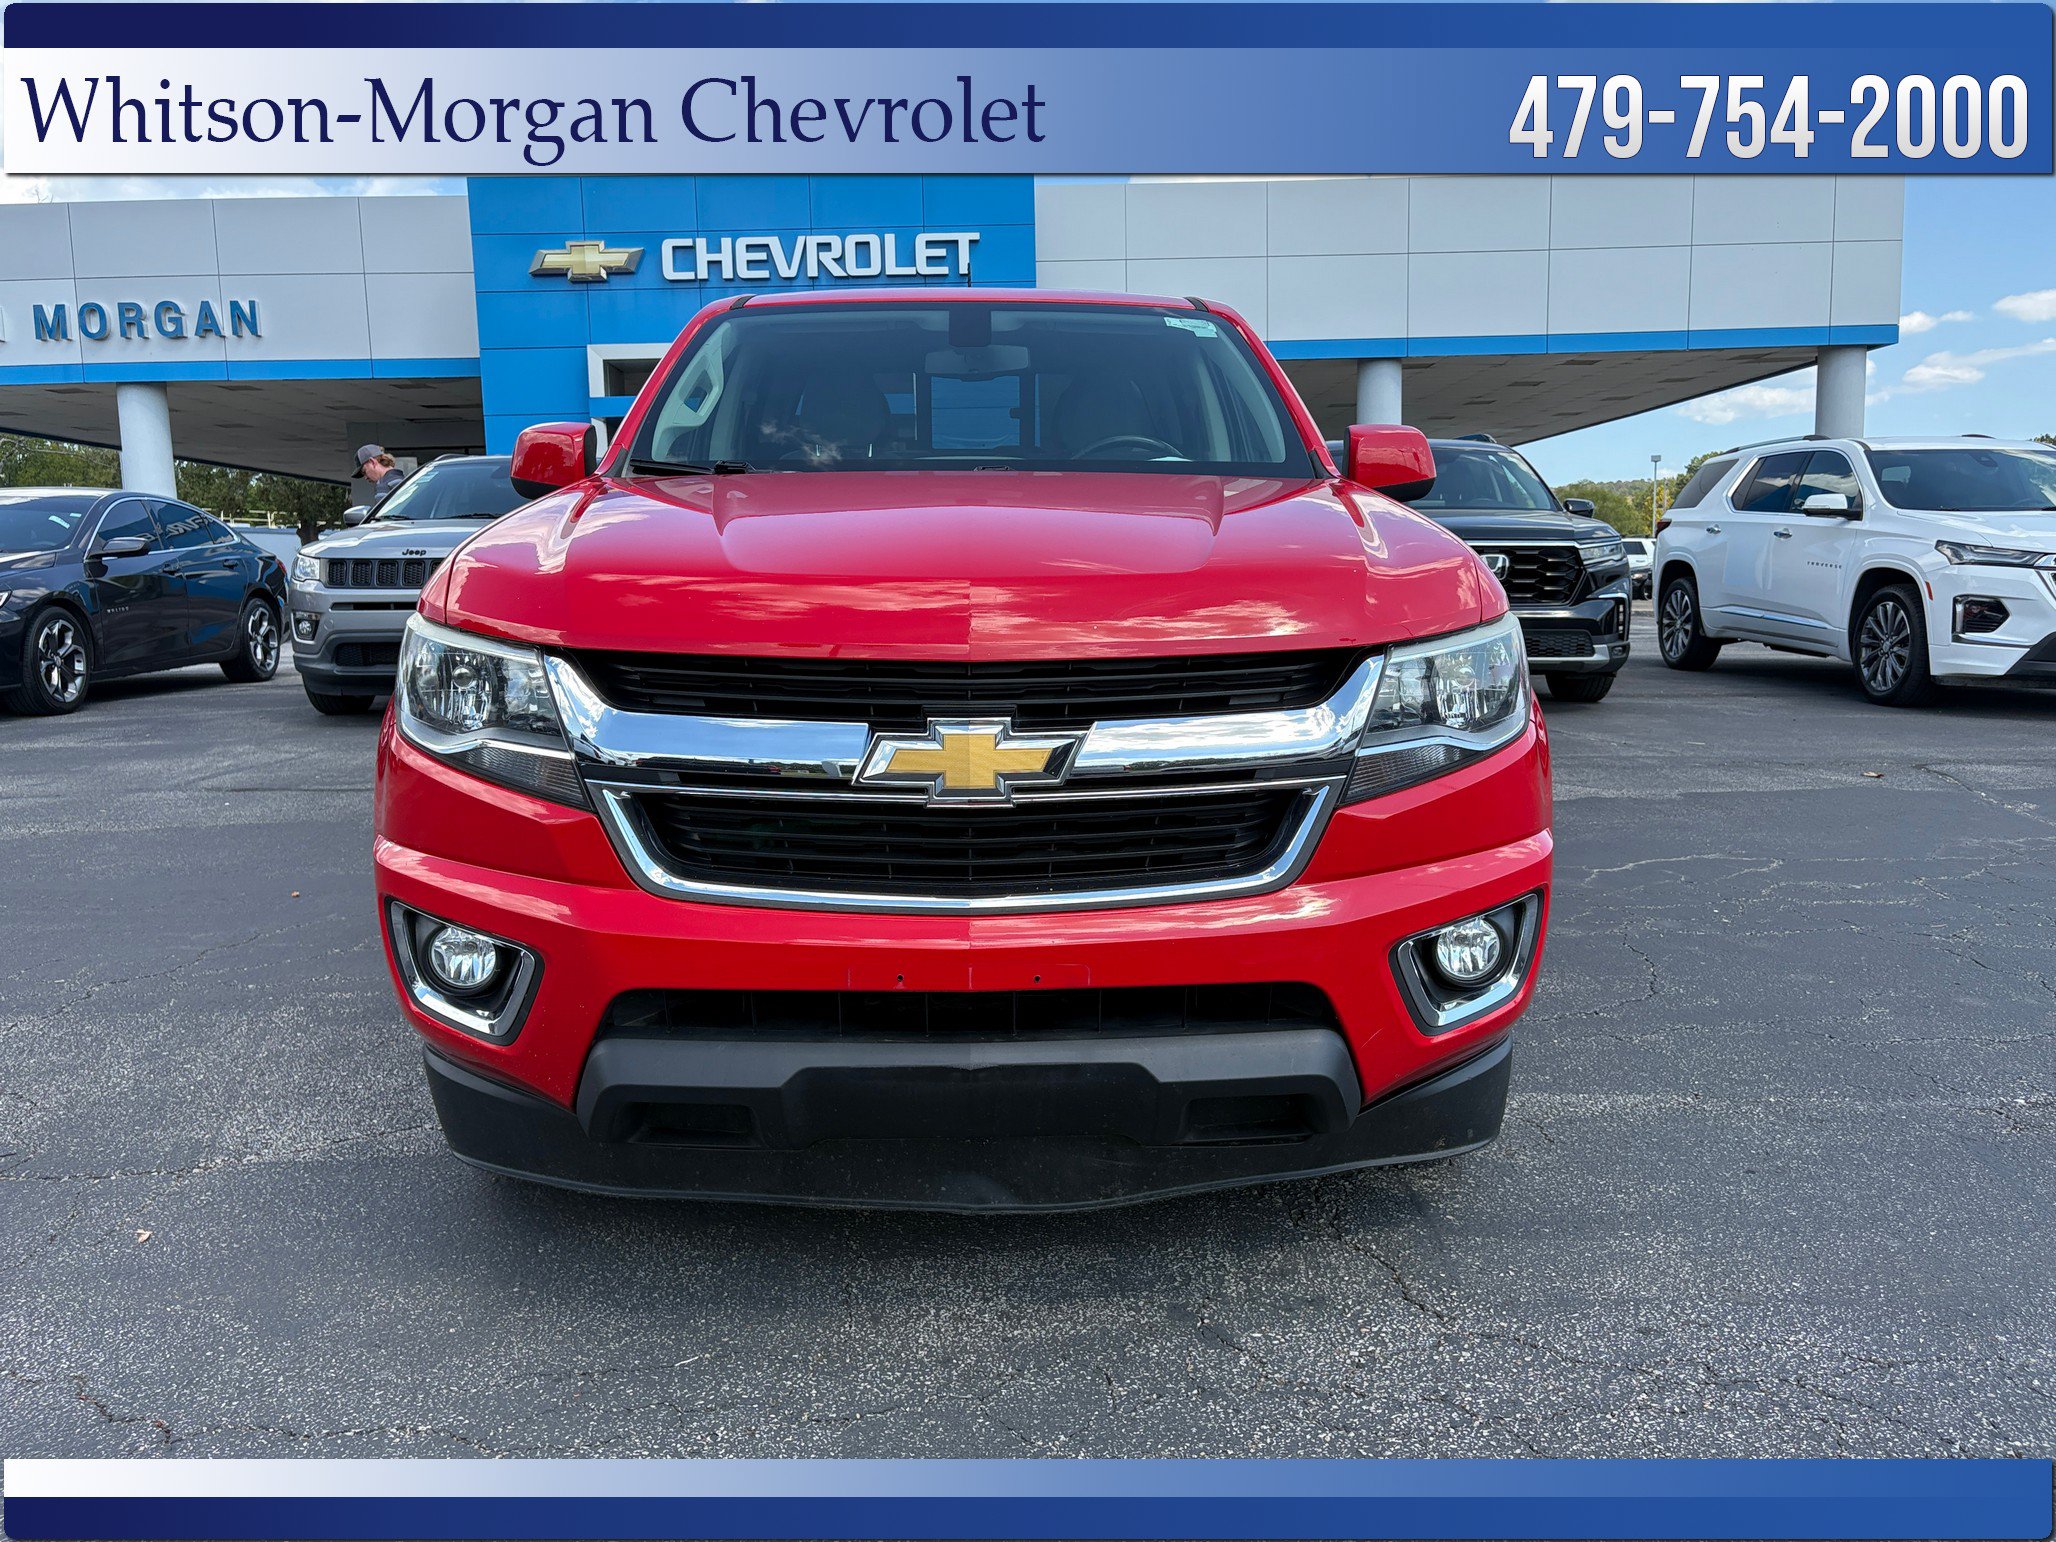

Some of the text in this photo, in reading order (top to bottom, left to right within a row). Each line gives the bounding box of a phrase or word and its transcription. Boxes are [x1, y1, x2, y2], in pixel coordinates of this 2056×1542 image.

[661, 232, 981, 281] CHEVROLET
[32, 299, 263, 343] MORGAN
[401, 548, 427, 557] Jeep
